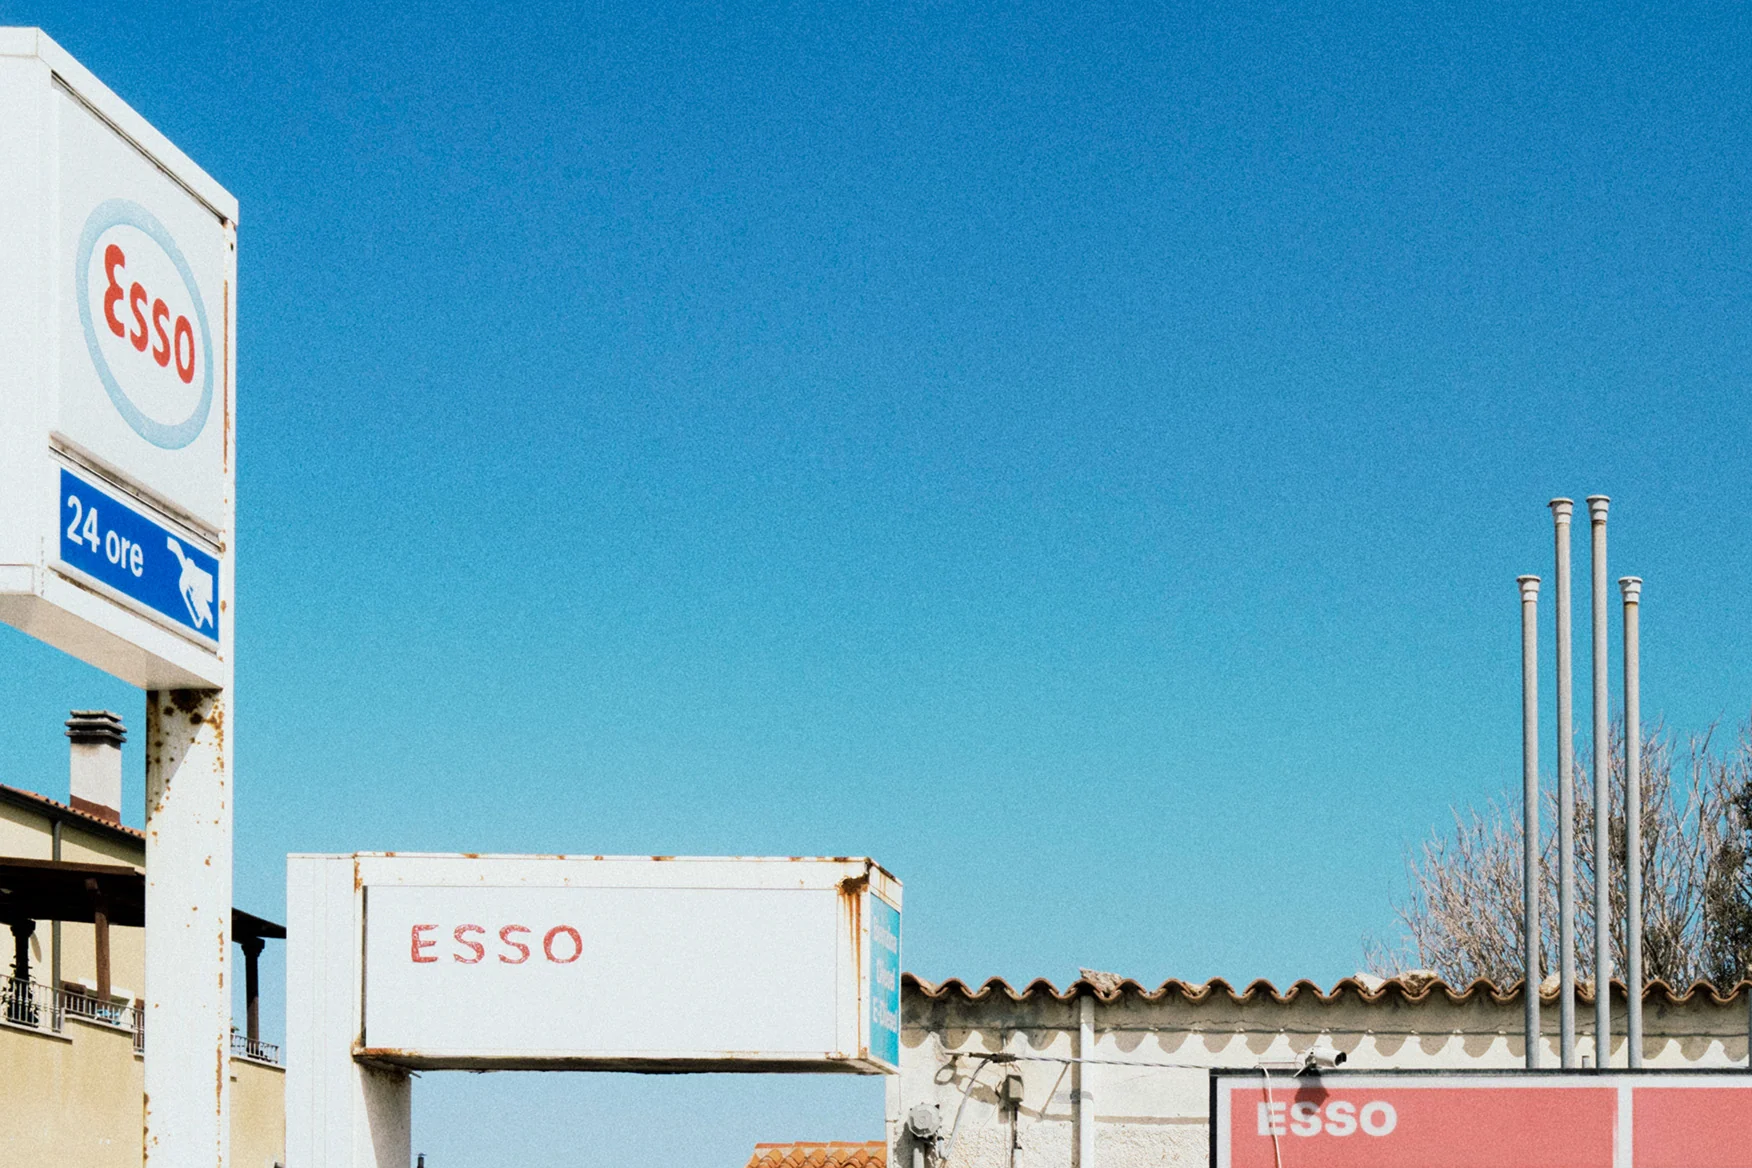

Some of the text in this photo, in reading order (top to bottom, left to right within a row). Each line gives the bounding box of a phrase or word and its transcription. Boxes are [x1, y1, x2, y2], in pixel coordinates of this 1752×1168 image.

[67, 494, 144, 579] 24 ore
[411, 923, 583, 964] ESSO
[1257, 1100, 1398, 1137] ESSO
